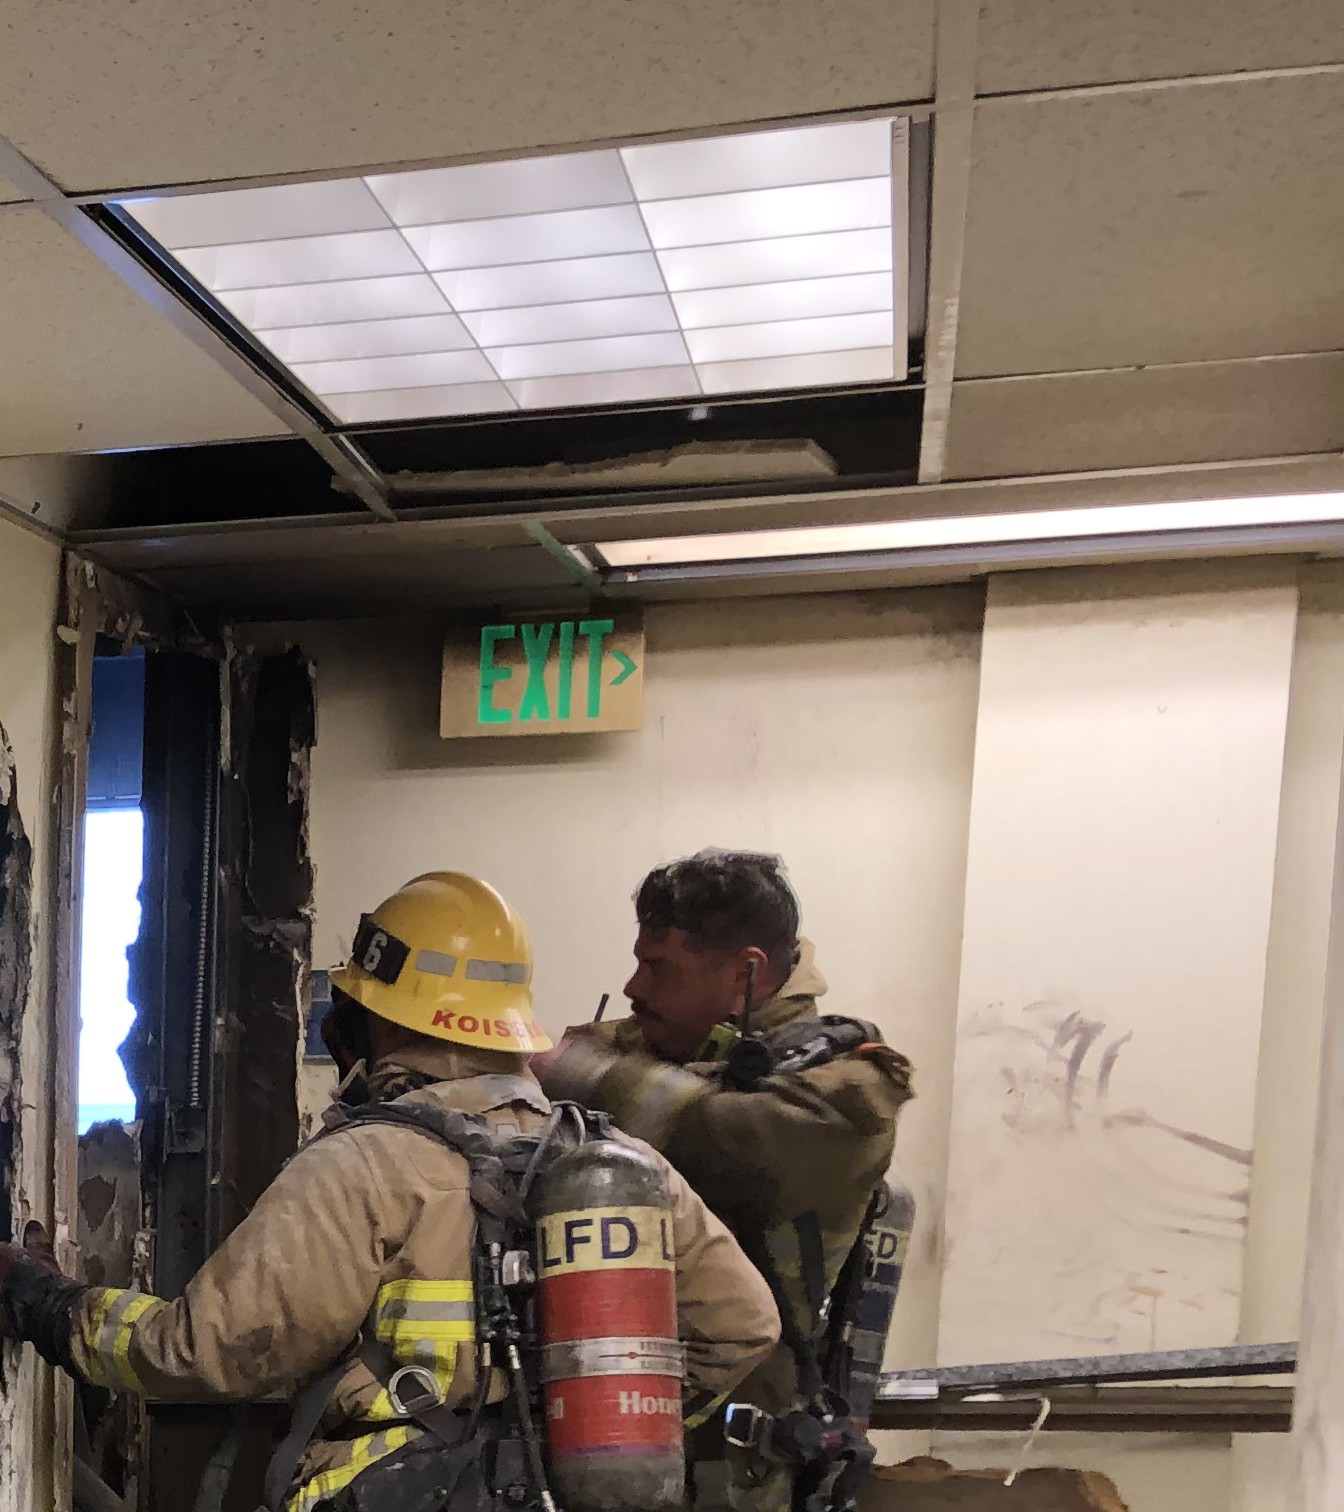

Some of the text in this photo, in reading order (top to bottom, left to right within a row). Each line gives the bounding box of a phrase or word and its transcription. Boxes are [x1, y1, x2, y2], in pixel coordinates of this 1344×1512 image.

[478, 619, 614, 723] EXIT
[363, 931, 388, 972] 6
[541, 1217, 639, 1268] LFD
